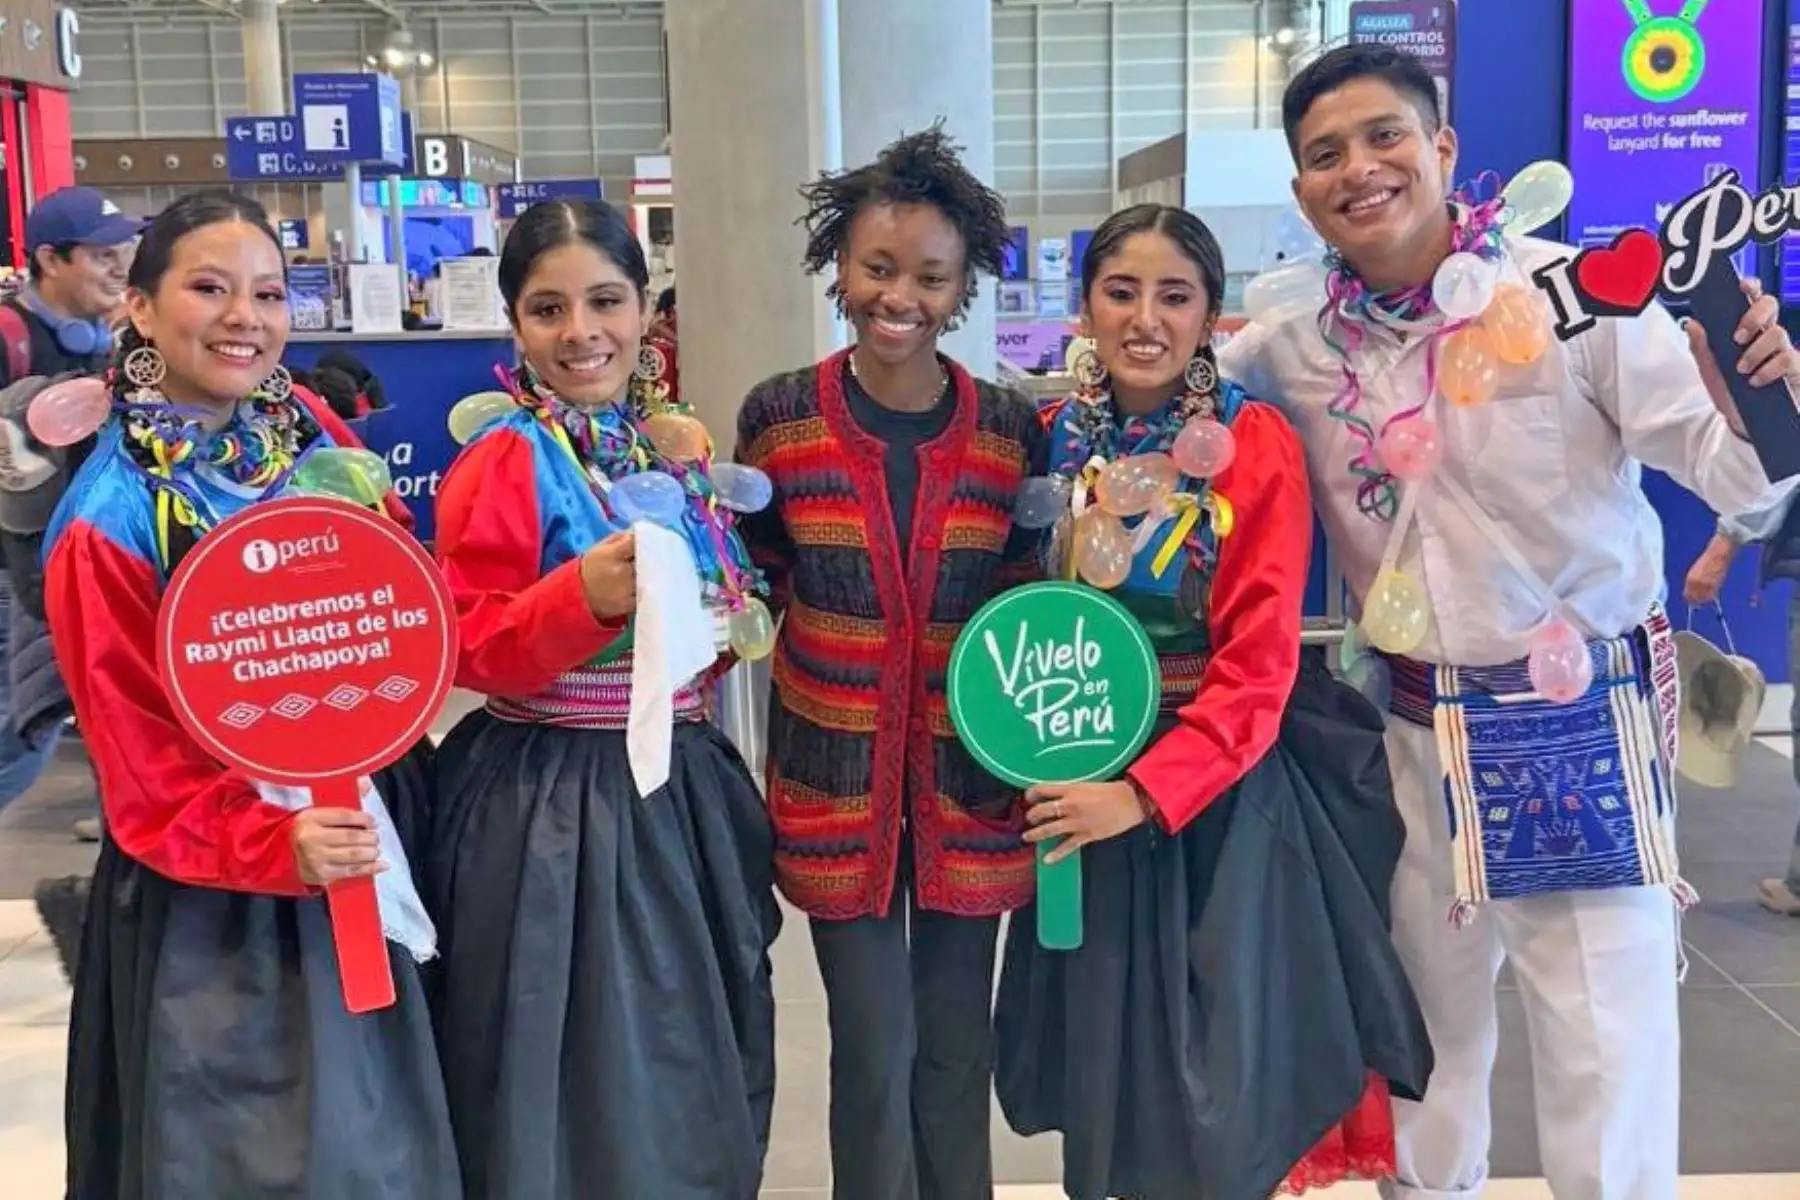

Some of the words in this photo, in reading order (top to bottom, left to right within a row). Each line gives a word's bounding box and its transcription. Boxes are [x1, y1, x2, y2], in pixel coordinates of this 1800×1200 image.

[59, 7, 82, 77] C
[1378, 32, 1444, 43] CONTROL
[1583, 114, 1638, 132] Request
[1642, 112, 1665, 129] the
[1669, 110, 1748, 127] sunflower
[1608, 134, 1659, 155] lanyard
[1662, 134, 1687, 148] for
[1690, 132, 1722, 148] free
[424, 138, 448, 177] B
[211, 590, 367, 637] ¡Celebremos
[371, 583, 396, 605] el
[185, 628, 267, 665] Raymi
[272, 620, 351, 651] Llaqta
[356, 611, 388, 635] de
[391, 606, 429, 630] los
[983, 614, 1102, 697] Vívelo
[232, 636, 393, 683] Chachapoya!
[1014, 676, 1115, 743] Perú
[1083, 678, 1110, 695] en
